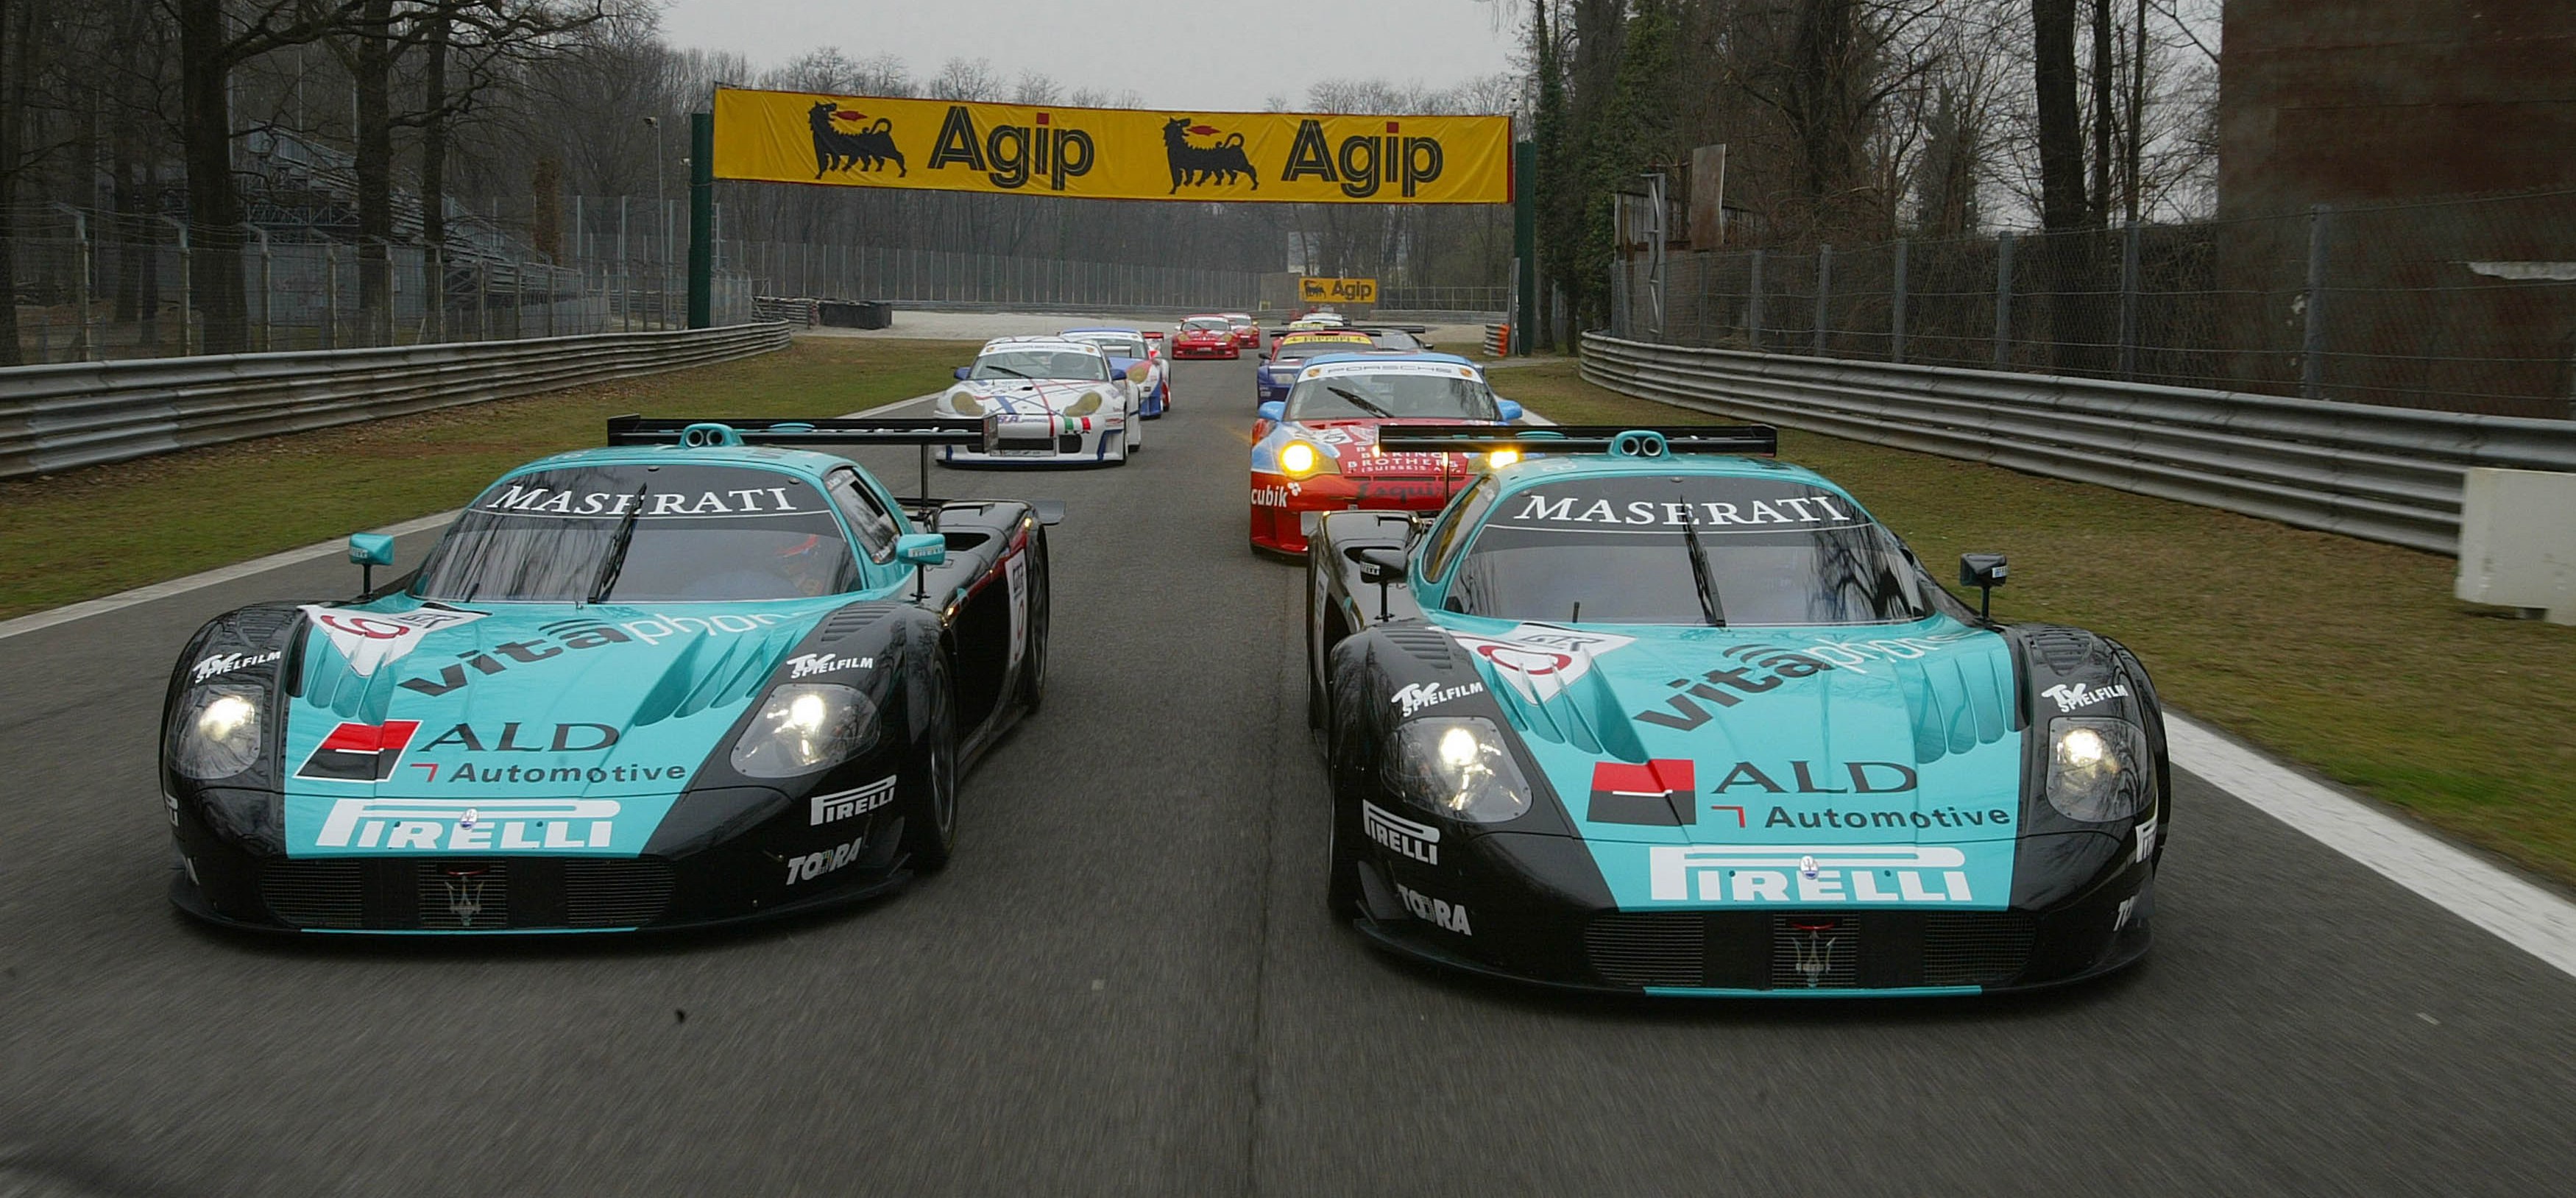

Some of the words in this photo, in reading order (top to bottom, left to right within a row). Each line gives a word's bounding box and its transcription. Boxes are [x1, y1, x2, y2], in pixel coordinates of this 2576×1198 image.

[927, 106, 1094, 191] Agip
[1281, 119, 1444, 199] Agip
[1330, 281, 1372, 300] Agip
[486, 484, 796, 516] MASERATI
[1251, 484, 1288, 508] cubik
[1512, 495, 1850, 525] MASERATI
[195, 651, 281, 684] SPIELFILM
[791, 657, 873, 678] SPIELFILM
[1402, 681, 1484, 717] SPIELFILM
[417, 722, 620, 753] ALD
[449, 762, 686, 784] Automotive
[1711, 761, 1918, 794] ALD
[810, 774, 897, 826] PIRELLI
[316, 798, 622, 850] PIRELLI
[1362, 798, 1440, 865] PIRELLI
[1766, 805, 2011, 829] Automotive
[1649, 846, 1972, 903] PIRELLI
